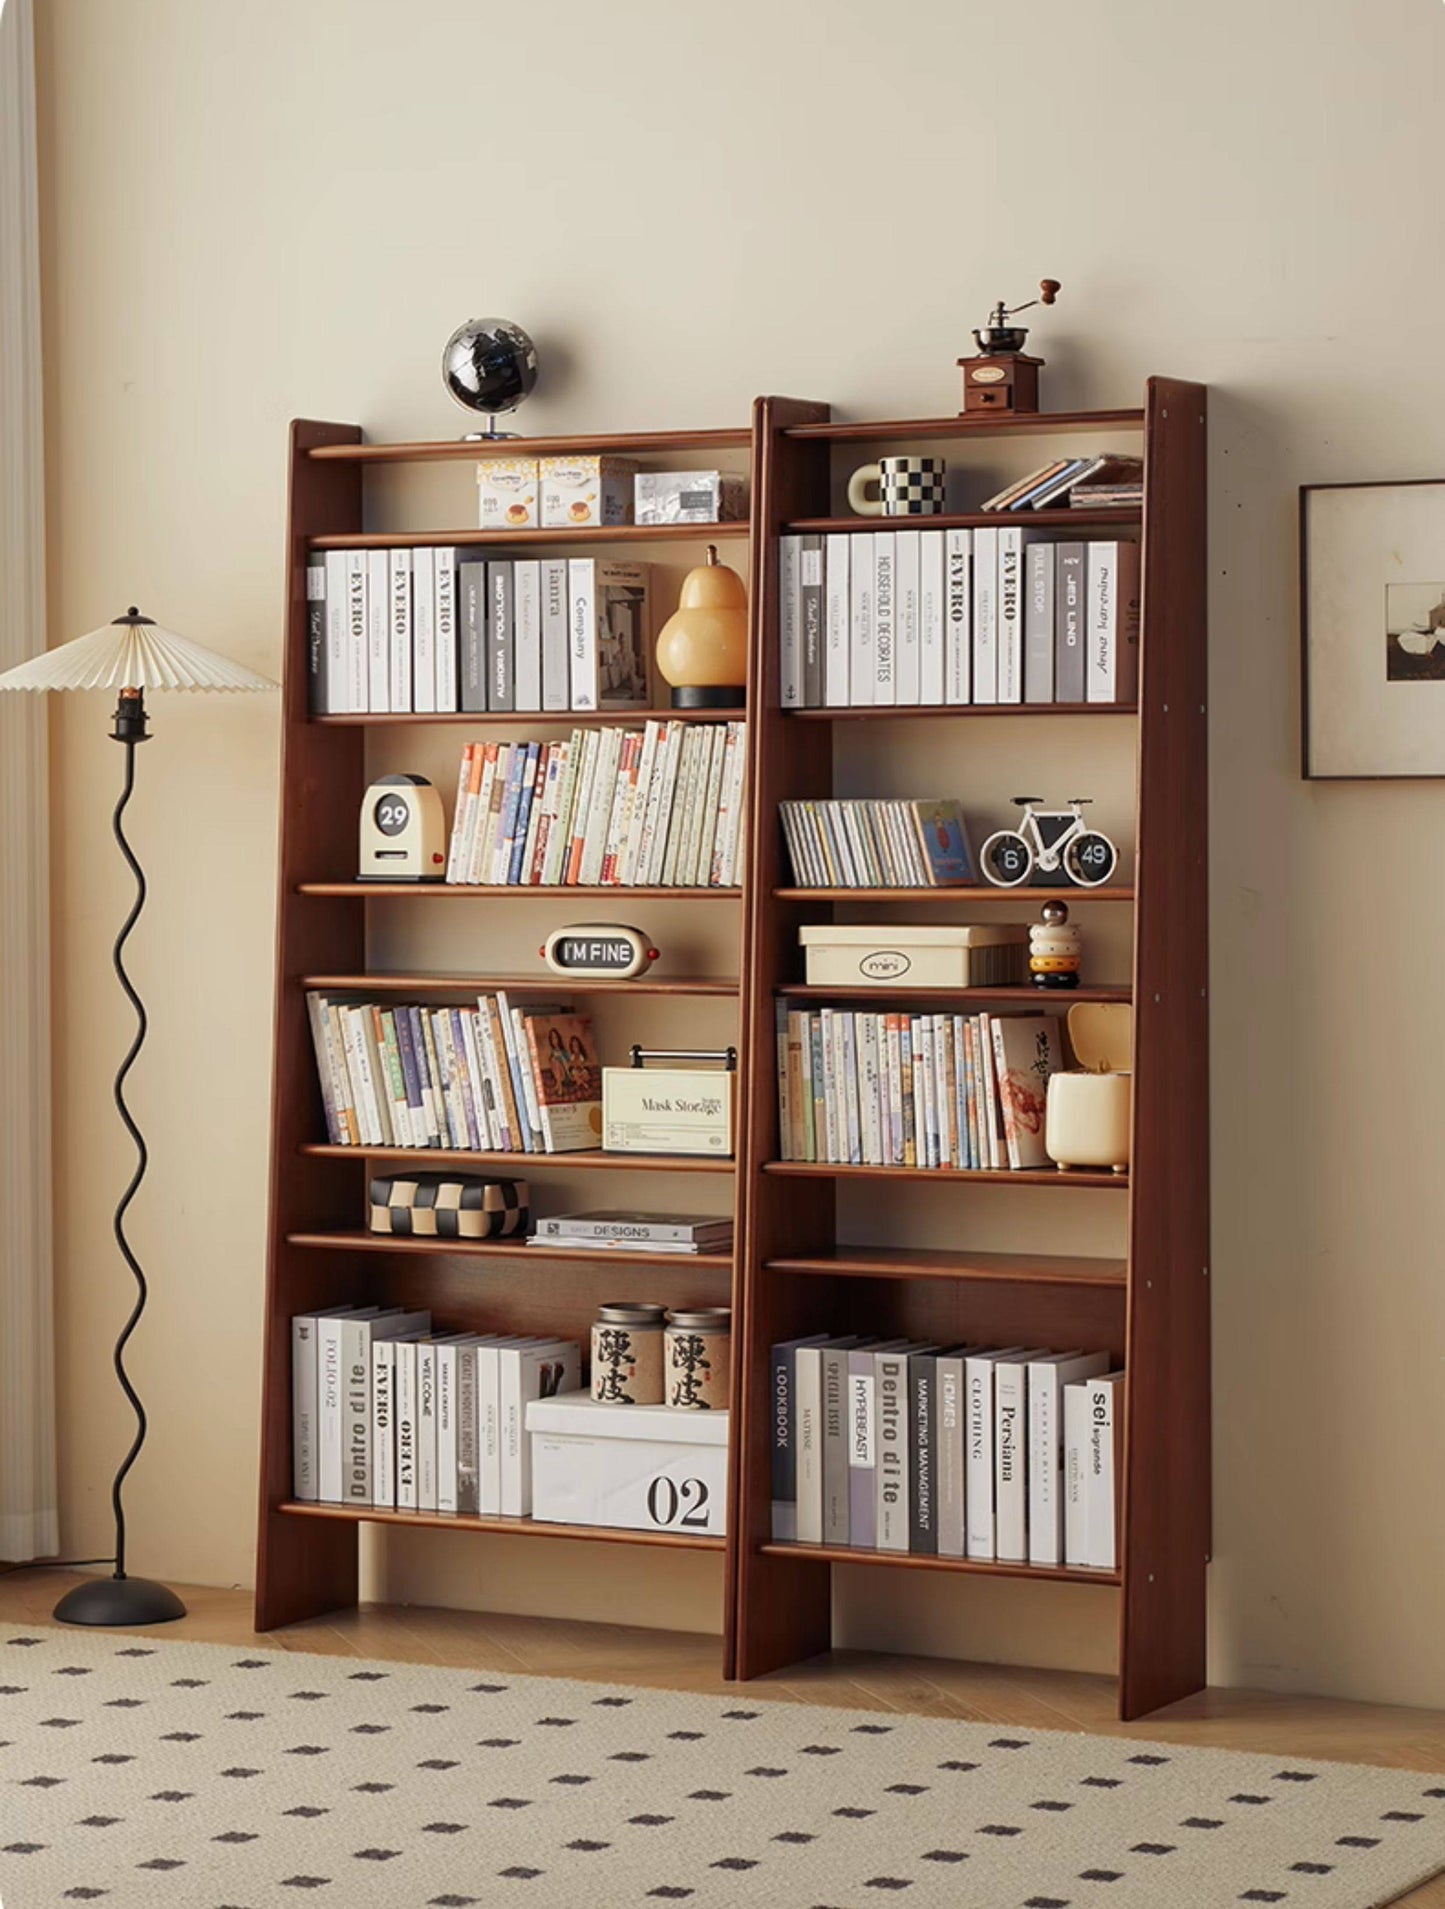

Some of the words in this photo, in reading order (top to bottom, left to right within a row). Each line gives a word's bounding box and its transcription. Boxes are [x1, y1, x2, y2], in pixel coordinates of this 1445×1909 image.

[877, 555, 891, 617] HOUSEHOLD
[950, 553, 964, 623] EVERO
[1003, 551, 1017, 621] EVERO
[1034, 547, 1045, 578] FULL
[352, 572, 363, 637] EVERO
[395, 570, 406, 634] EVERO
[439, 569, 451, 634] EVERO
[496, 575, 505, 641] FOLKLORE
[575, 597, 588, 660] Company
[877, 622, 892, 683] DECORATES
[381, 806, 407, 826] 29
[1082, 844, 1106, 864] 49
[564, 942, 587, 961] I'M
[590, 943, 630, 962] FINE
[868, 958, 899, 970] mini
[641, 1098, 673, 1112] Mask
[594, 1225, 650, 1238] DESIGNS
[350, 1364, 366, 1385] te
[376, 1363, 389, 1429] EVERO
[422, 1357, 433, 1417] WELCOME
[598, 1329, 636, 1404] 陳皮
[673, 1335, 711, 1409] 陳皮
[827, 1361, 839, 1404] SPECIAL
[349, 1392, 366, 1414] di
[776, 1365, 788, 1448] LOOKBOOK
[855, 1378, 868, 1462] HYPEBEAST
[882, 1362, 900, 1441] Dentro
[917, 1377, 929, 1446] MARKETING
[943, 1373, 956, 1428] HOMES
[971, 1377, 983, 1461] CLOTHING
[1092, 1391, 1111, 1427] sei
[350, 1422, 367, 1498] Dentro
[401, 1419, 413, 1486] EVERO
[883, 1451, 901, 1475] di
[1002, 1405, 1017, 1483] Persiana
[647, 1475, 710, 1528] 02
[882, 1481, 900, 1504] te
[918, 1448, 930, 1531] MANAGEMENT
